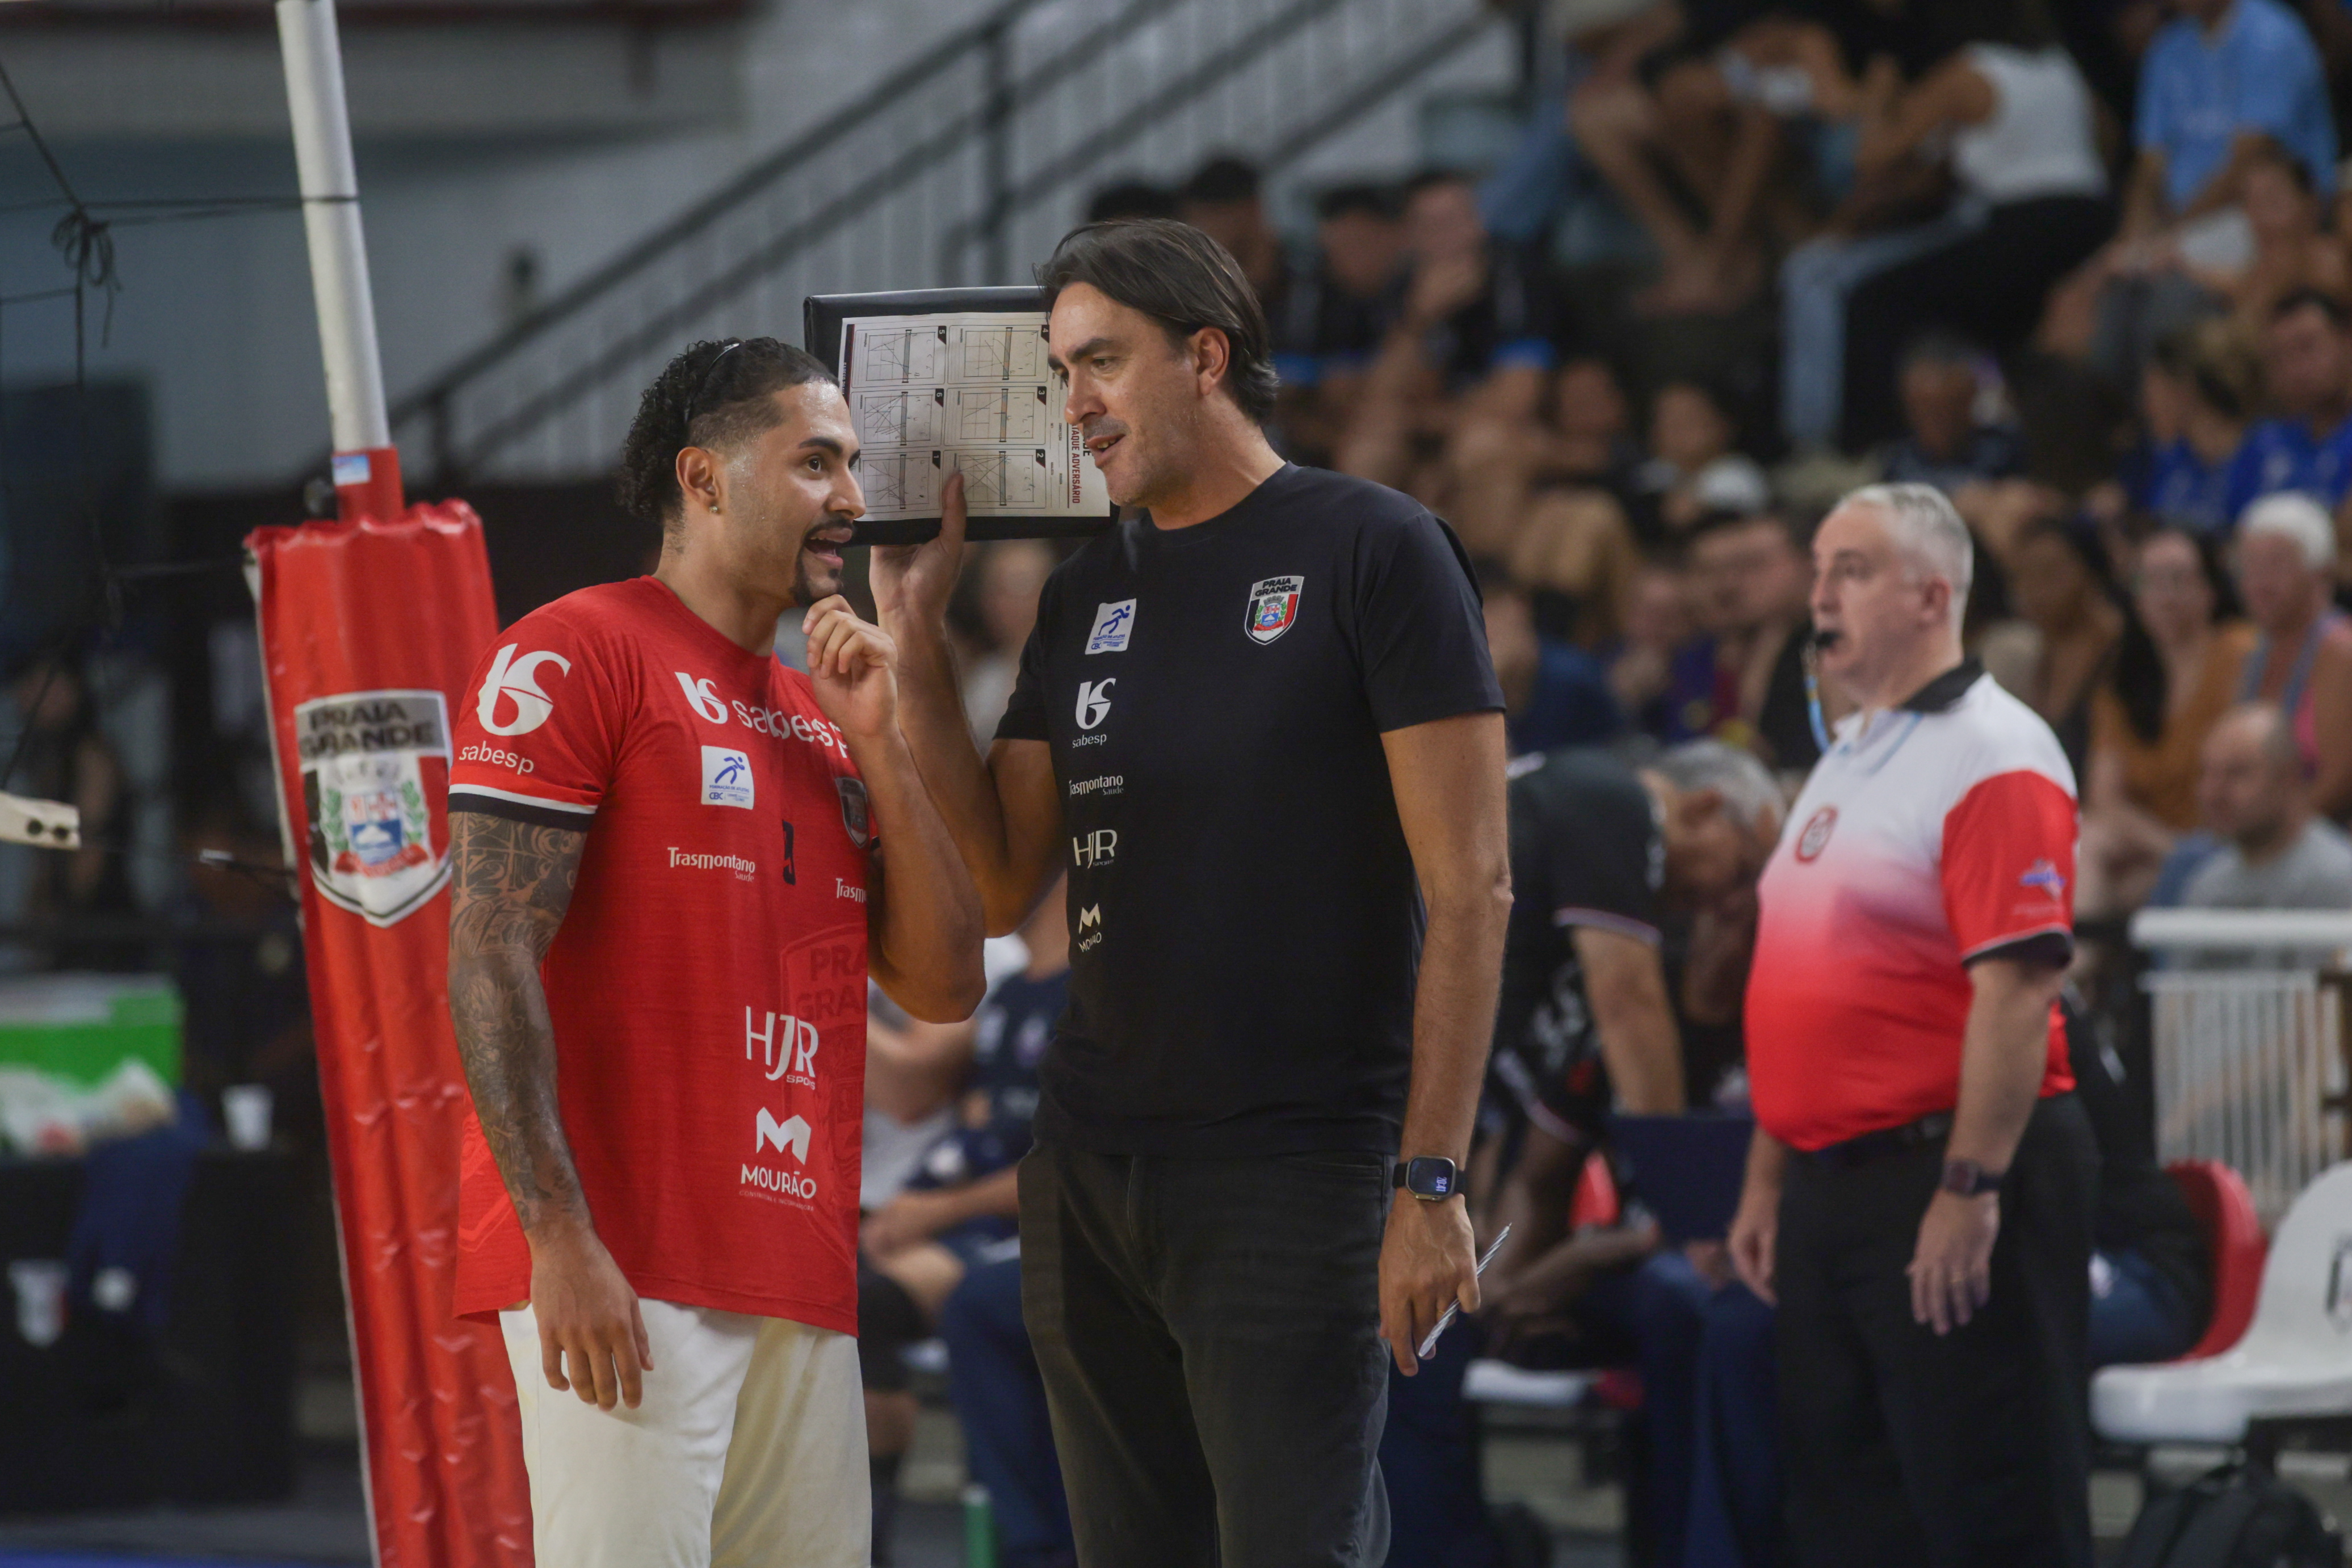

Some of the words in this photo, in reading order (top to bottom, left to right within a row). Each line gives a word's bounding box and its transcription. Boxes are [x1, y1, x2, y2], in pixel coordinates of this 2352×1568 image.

[1071, 453, 1082, 503] ADVERSÁRIO
[1255, 585, 1297, 596] GRANDE
[1262, 577, 1291, 588] PRAIA
[308, 701, 407, 730] PRAIA
[299, 721, 433, 759] GRANDE
[1072, 733, 1107, 749] sabesp
[459, 740, 534, 775] sabesp
[667, 847, 755, 873] Trasmontano
[1073, 829, 1118, 869] HJR
[746, 1005, 819, 1081] HJR
[741, 1163, 817, 1199] MOURÃO
[1435, 1176, 1447, 1192] 20:41
